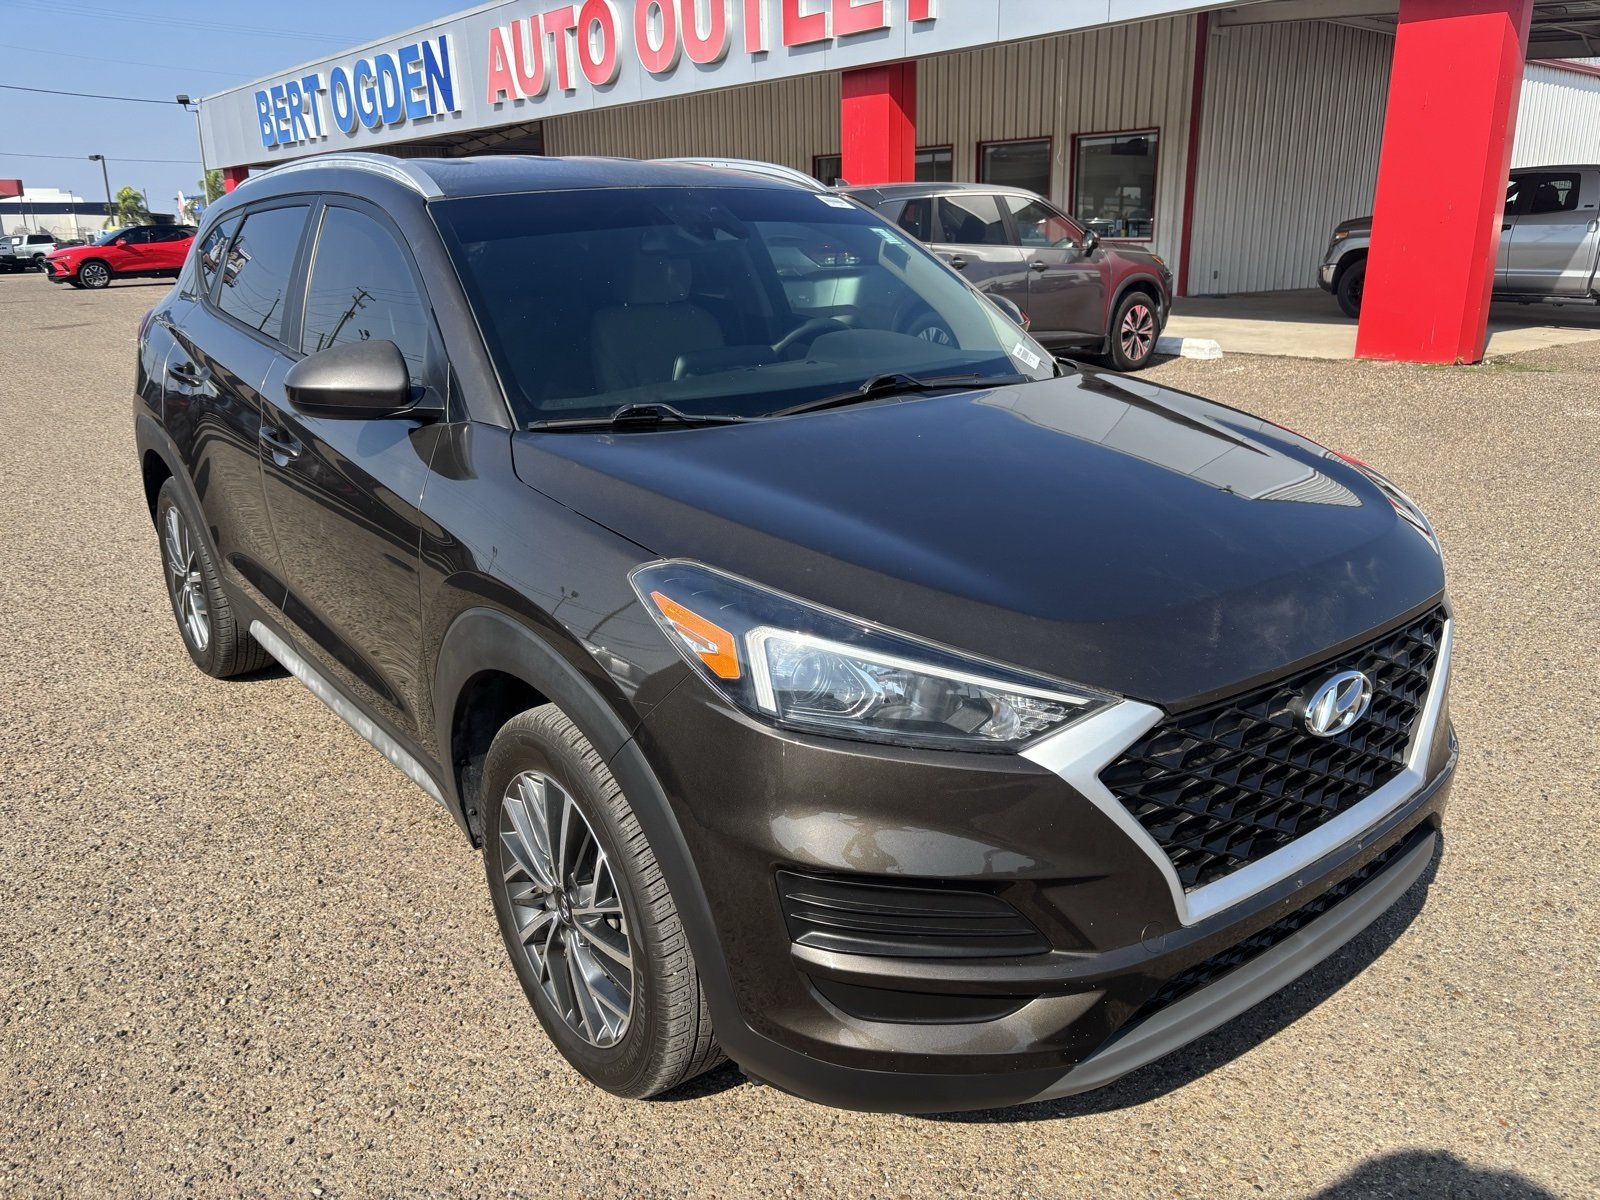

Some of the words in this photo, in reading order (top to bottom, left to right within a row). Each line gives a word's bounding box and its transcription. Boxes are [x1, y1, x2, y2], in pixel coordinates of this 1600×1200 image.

[254, 73, 325, 147] BERT
[329, 34, 459, 134] OGDEN
[487, 0, 620, 104] AUTO
[634, 0, 936, 73] OUTL
